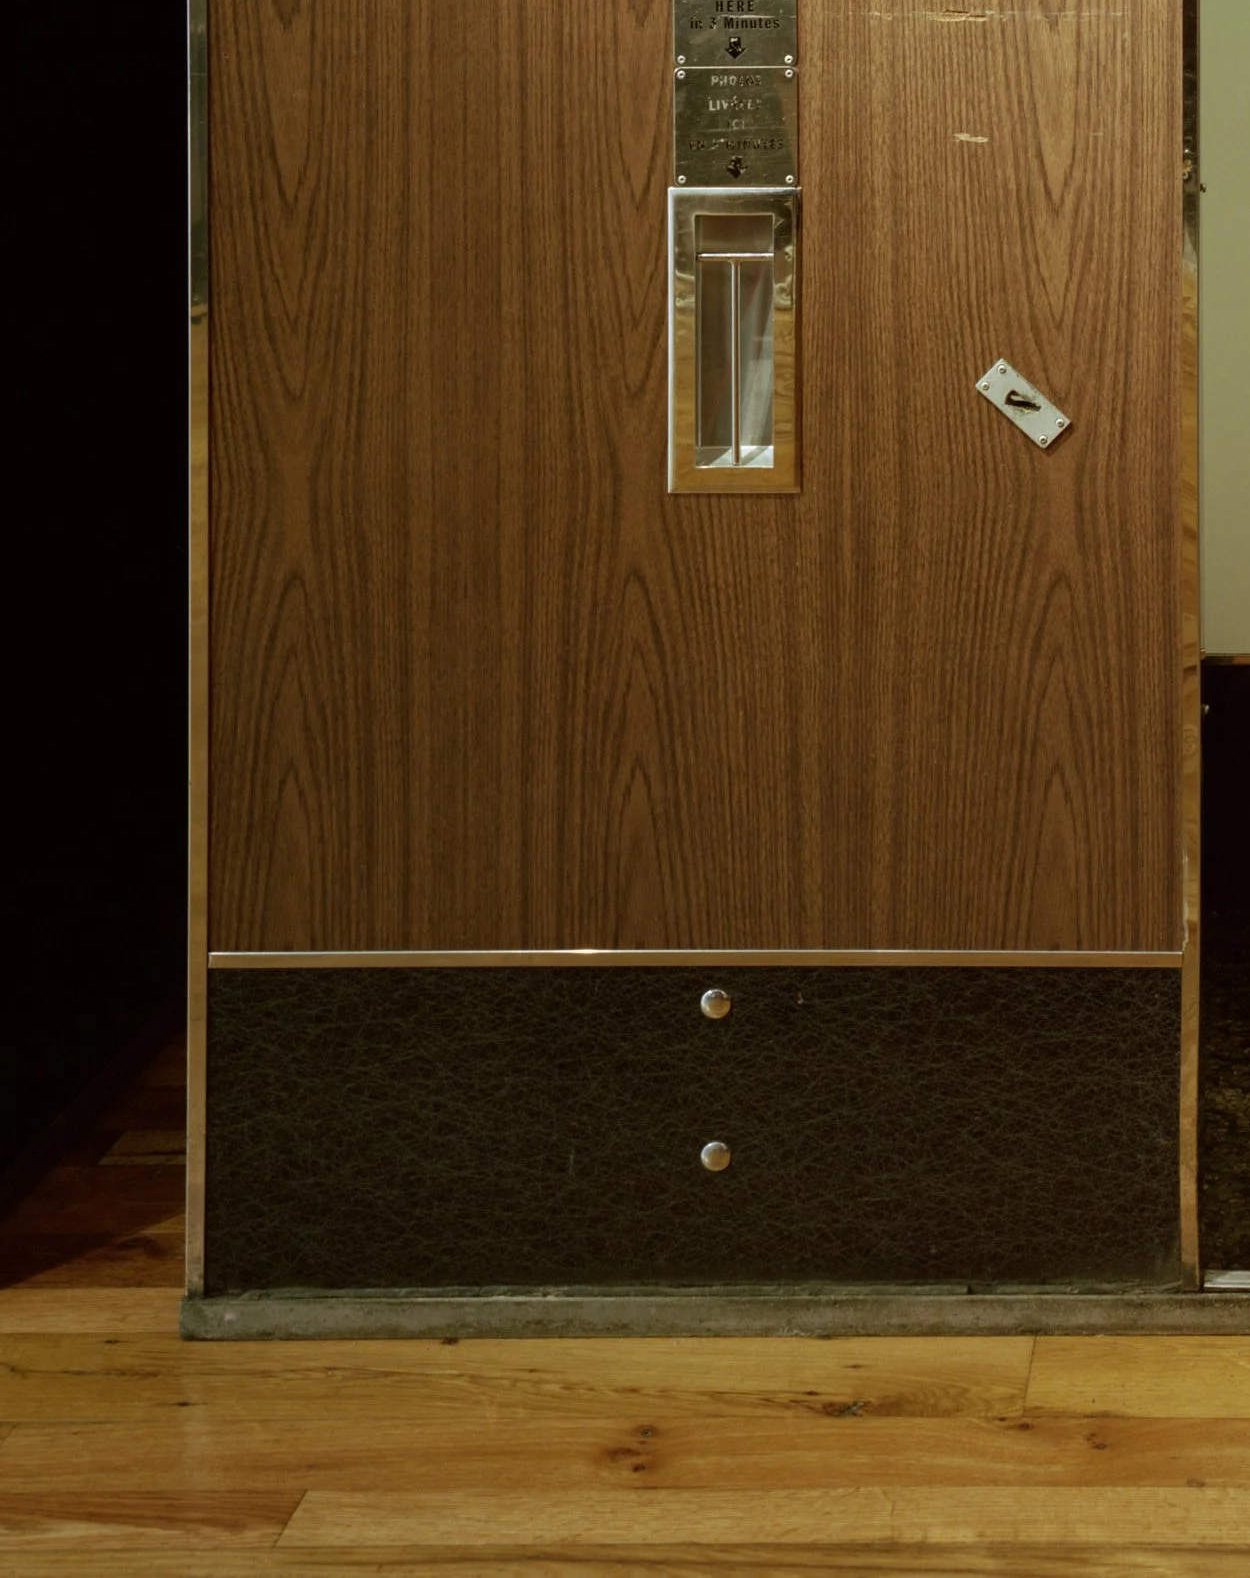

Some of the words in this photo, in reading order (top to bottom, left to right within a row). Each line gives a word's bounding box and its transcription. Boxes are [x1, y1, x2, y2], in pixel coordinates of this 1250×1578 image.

[715, 0, 755, 13] HERE
[689, 16, 703, 30] in
[709, 16, 718, 30] 3
[723, 16, 781, 30] Minutes
